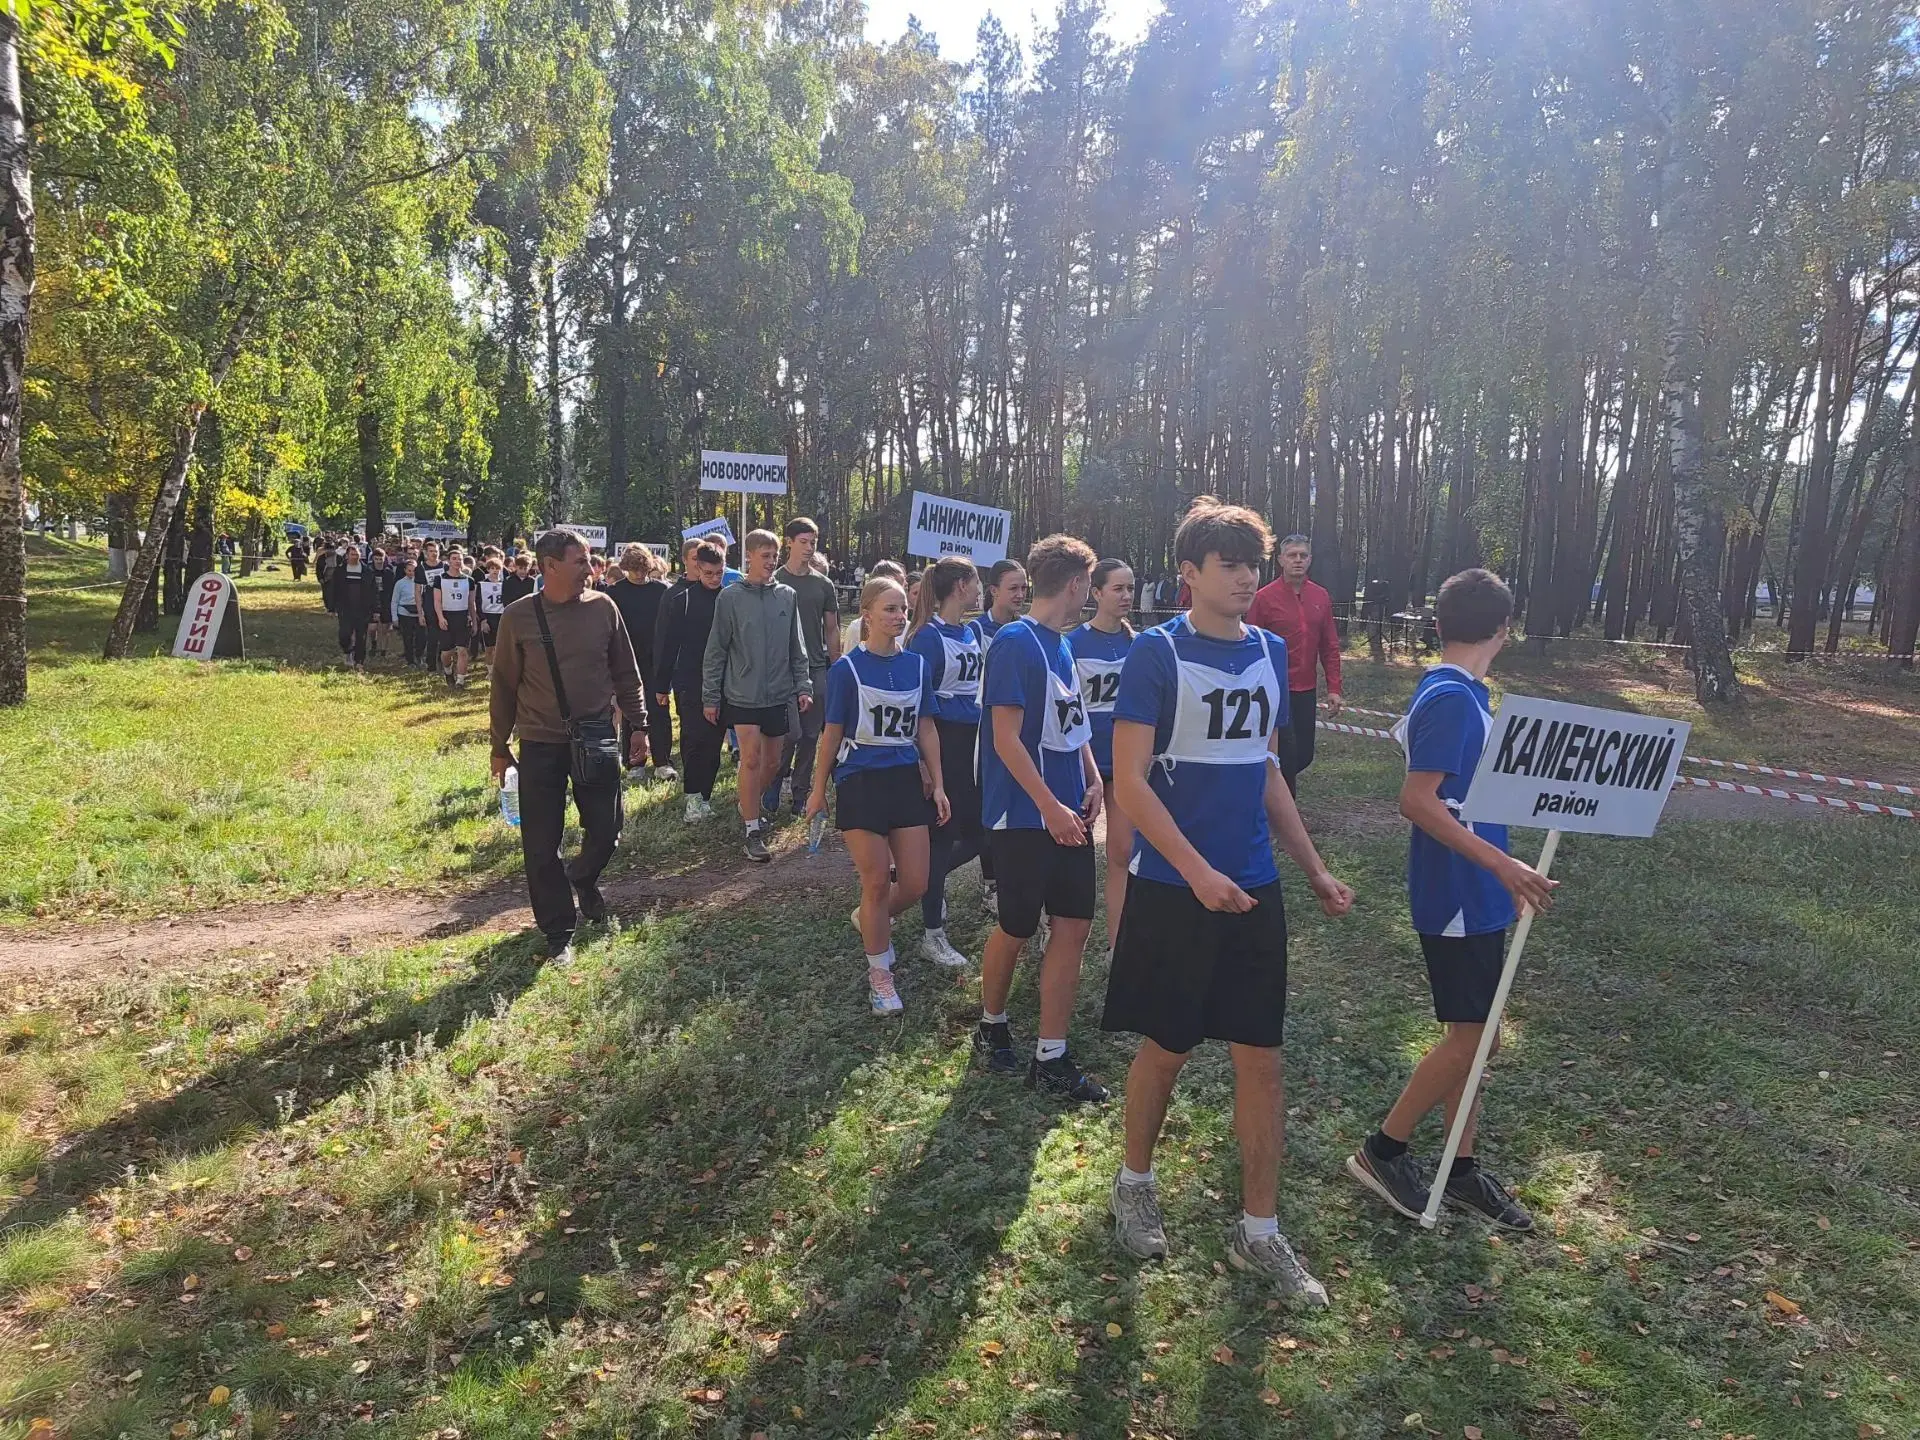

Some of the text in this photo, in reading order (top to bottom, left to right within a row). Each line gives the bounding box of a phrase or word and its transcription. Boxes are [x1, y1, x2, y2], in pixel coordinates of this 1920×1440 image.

[702, 460, 786, 483] НОВОВОРОНЕЖ
[917, 501, 1004, 544] АННИНСКИЙ
[940, 540, 973, 555] район
[487, 594, 503, 604] 18
[183, 579, 222, 653] ФИНИШ
[869, 704, 916, 737] 125
[1201, 685, 1270, 739] 121
[1493, 714, 1676, 792] КАМЕНСКИЙ
[1532, 790, 1599, 816] район
